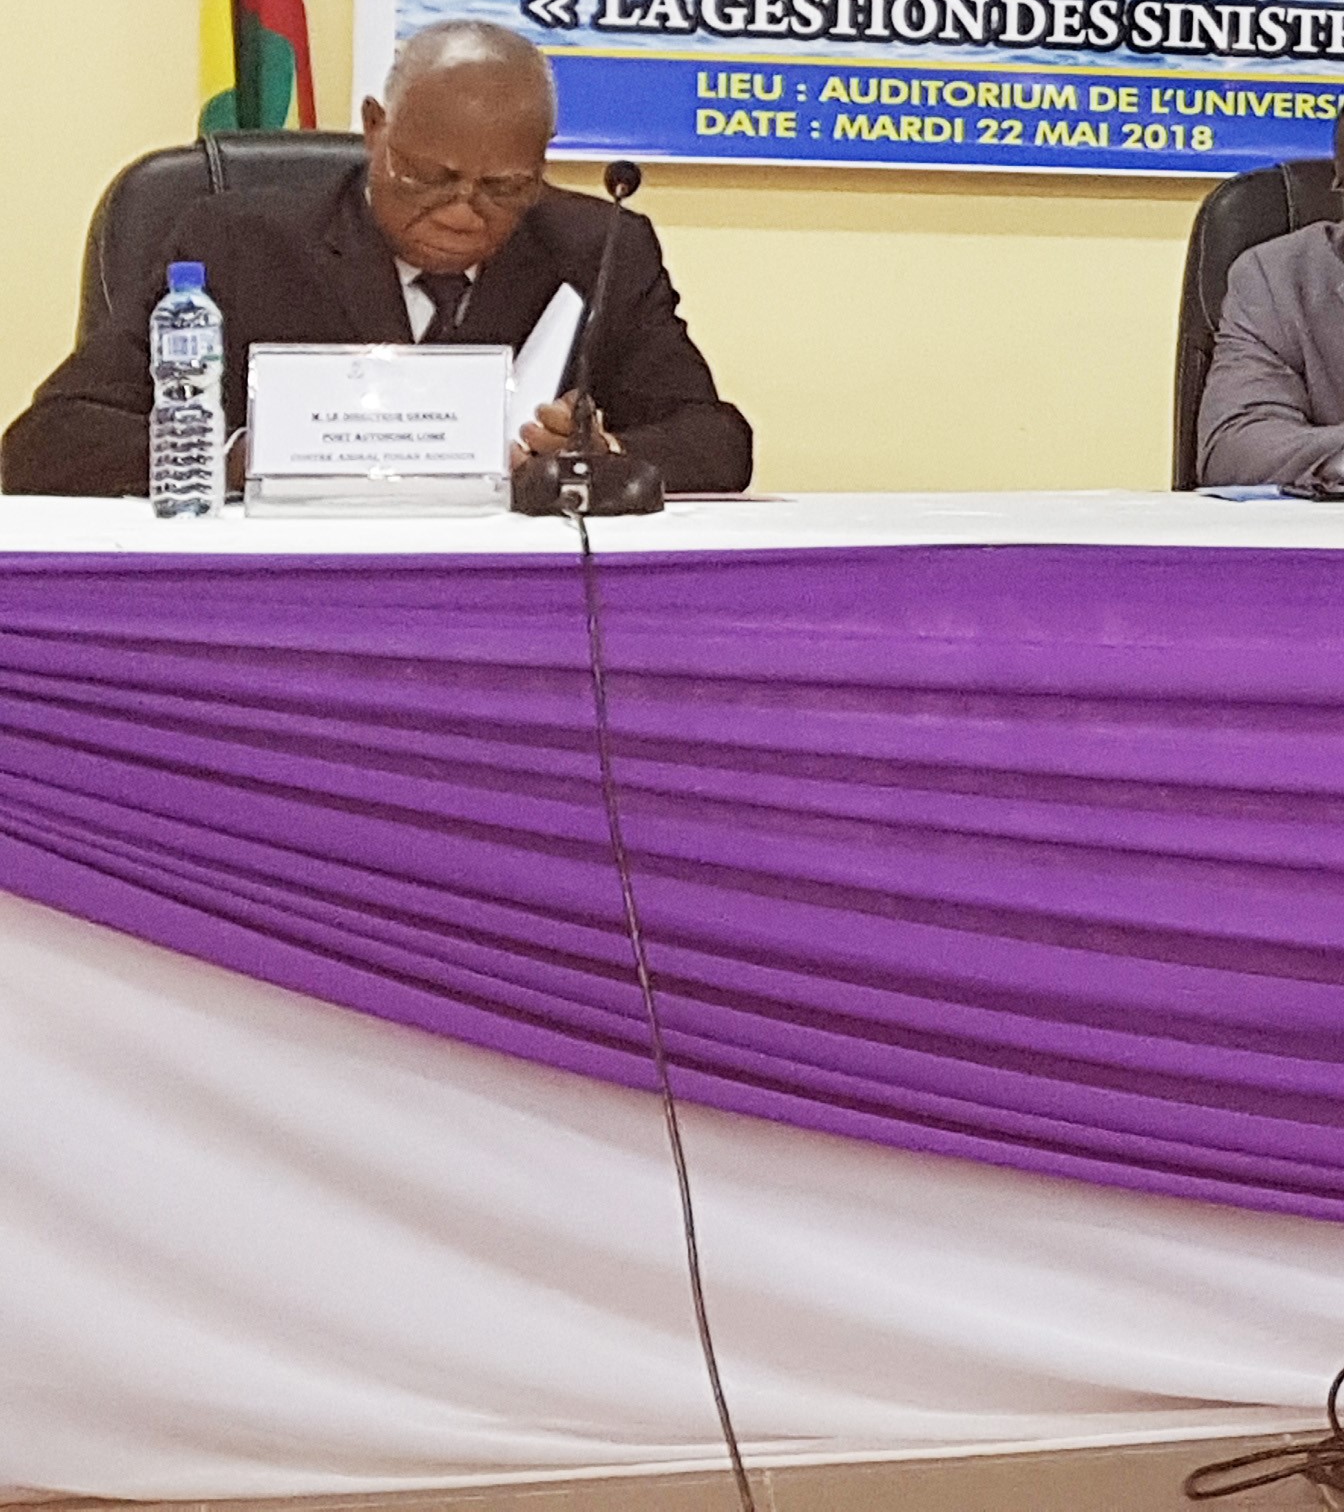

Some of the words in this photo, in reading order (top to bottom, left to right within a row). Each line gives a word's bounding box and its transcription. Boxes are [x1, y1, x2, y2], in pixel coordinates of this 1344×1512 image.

[697, 72, 782, 102] LIEU
[797, 80, 806, 102] :
[818, 76, 1078, 112] AUDITORIUM
[1088, 87, 1138, 115] DE
[697, 110, 797, 139] DATE
[811, 116, 819, 139] :
[833, 113, 964, 144] MARDI
[976, 118, 1022, 146] 22
[1033, 120, 1112, 148] MAI
[1122, 123, 1213, 152] 2018
